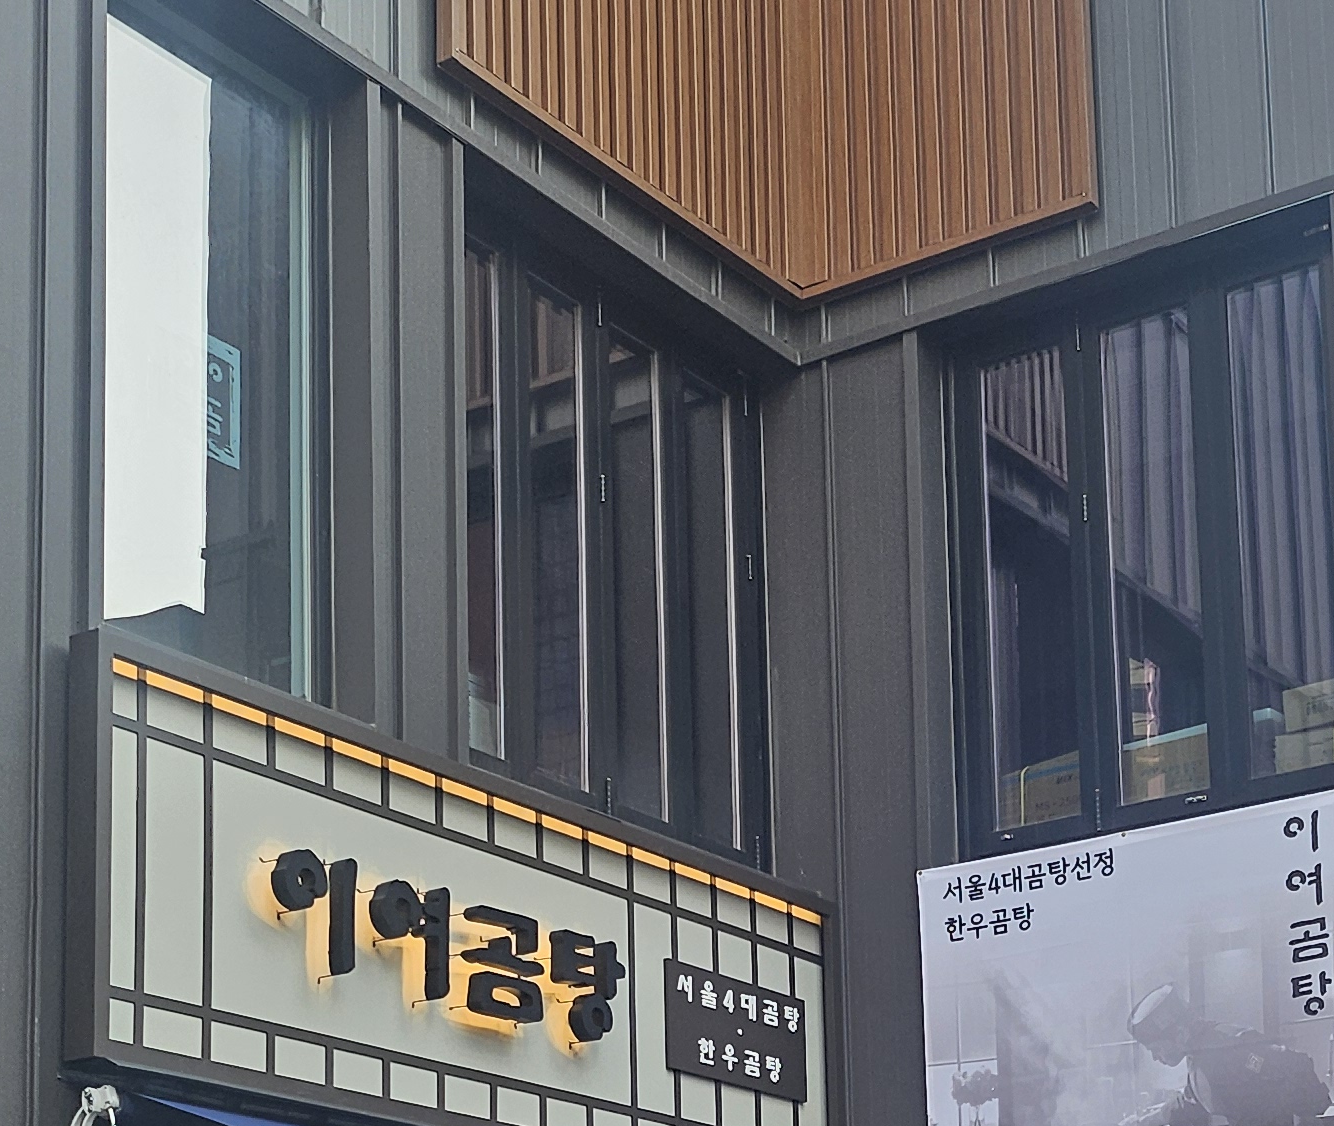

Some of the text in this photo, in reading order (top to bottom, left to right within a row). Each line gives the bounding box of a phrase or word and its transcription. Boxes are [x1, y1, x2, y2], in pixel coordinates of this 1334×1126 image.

[942, 847, 1115, 904] 서울4대곰탕선정
[944, 904, 1035, 942] 한우곰탕
[1283, 810, 1334, 1016] 이여곰탕
[272, 849, 626, 1043] 이여곰탕
[697, 1038, 784, 1084] 한우곰탕
